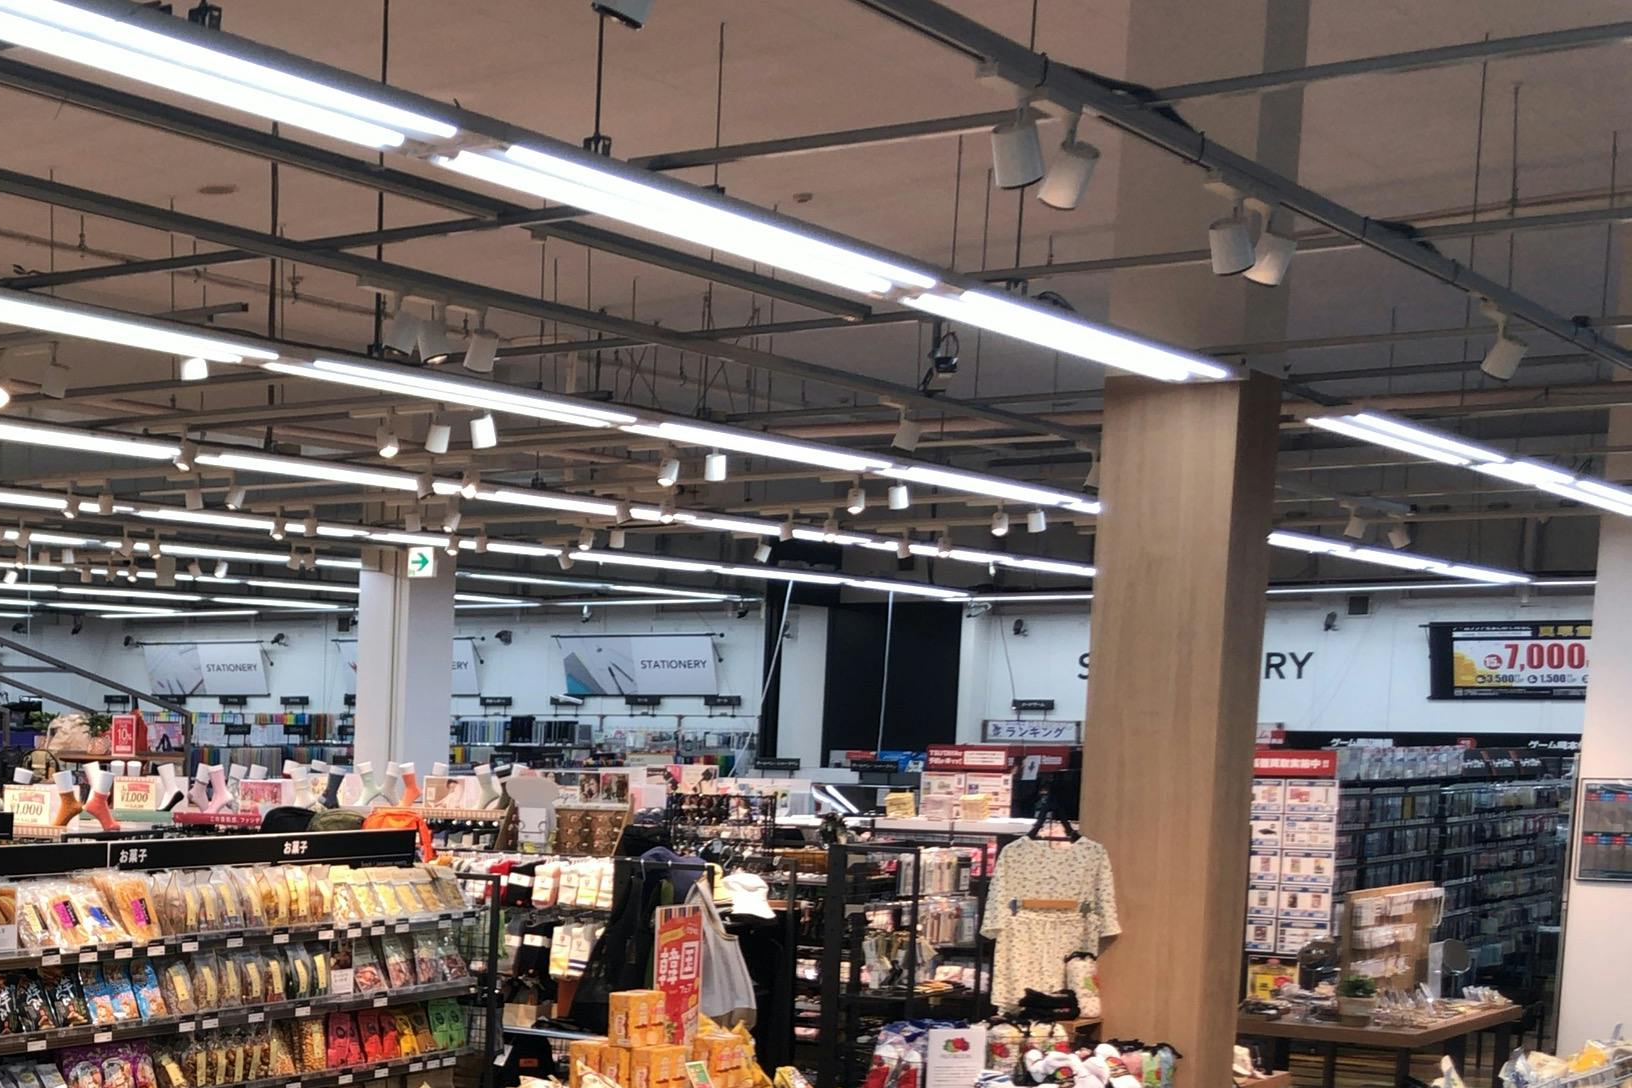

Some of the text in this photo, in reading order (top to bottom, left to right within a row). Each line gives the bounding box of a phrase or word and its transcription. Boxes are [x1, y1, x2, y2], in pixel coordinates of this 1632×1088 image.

[1504, 643, 1586, 672] 7,000
[206, 663, 257, 673] STATIONERY
[640, 659, 707, 670] STATIONERY
[1006, 726, 1066, 738] ランキング
[283, 841, 308, 855] お菓子
[119, 848, 148, 863] お菓子
